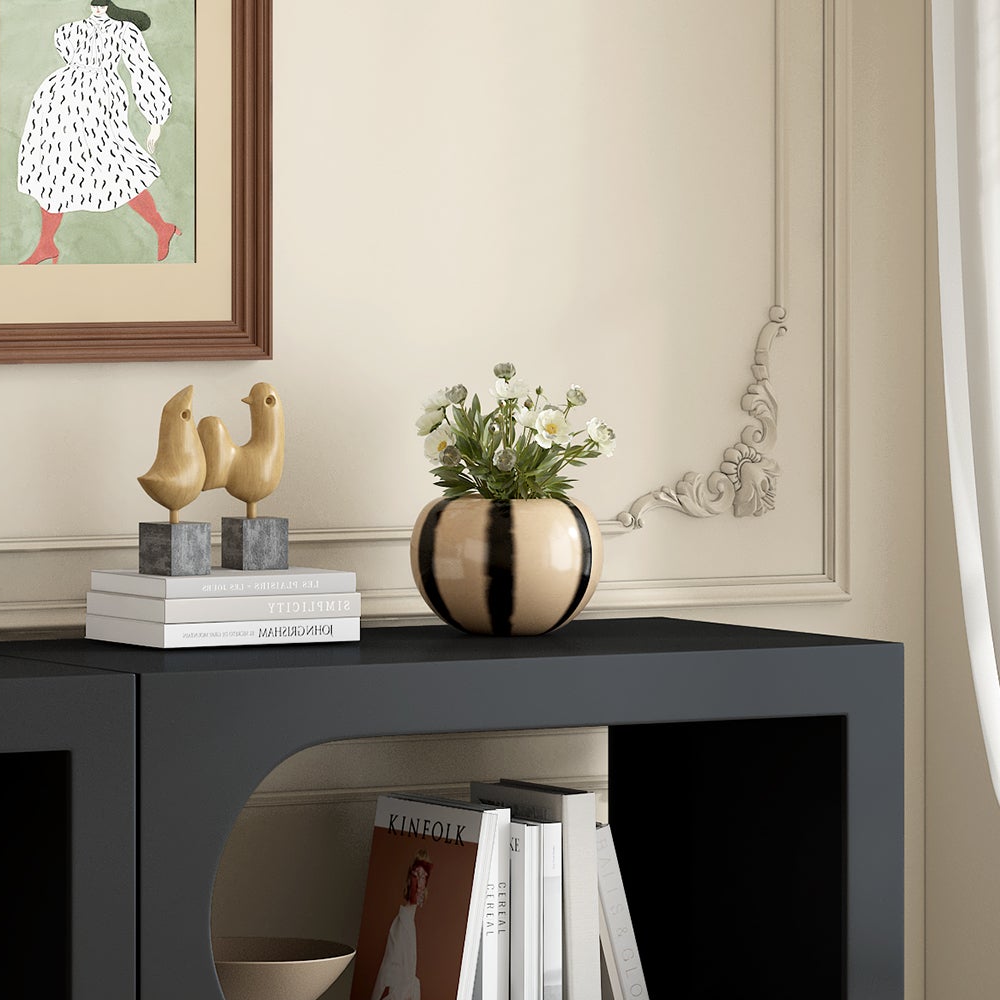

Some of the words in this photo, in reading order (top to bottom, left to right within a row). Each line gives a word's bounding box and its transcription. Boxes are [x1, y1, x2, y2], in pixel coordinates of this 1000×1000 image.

[388, 814, 466, 846] KINFOLK
[486, 883, 495, 937] CEREAL
[497, 881, 506, 935] CEREAL
